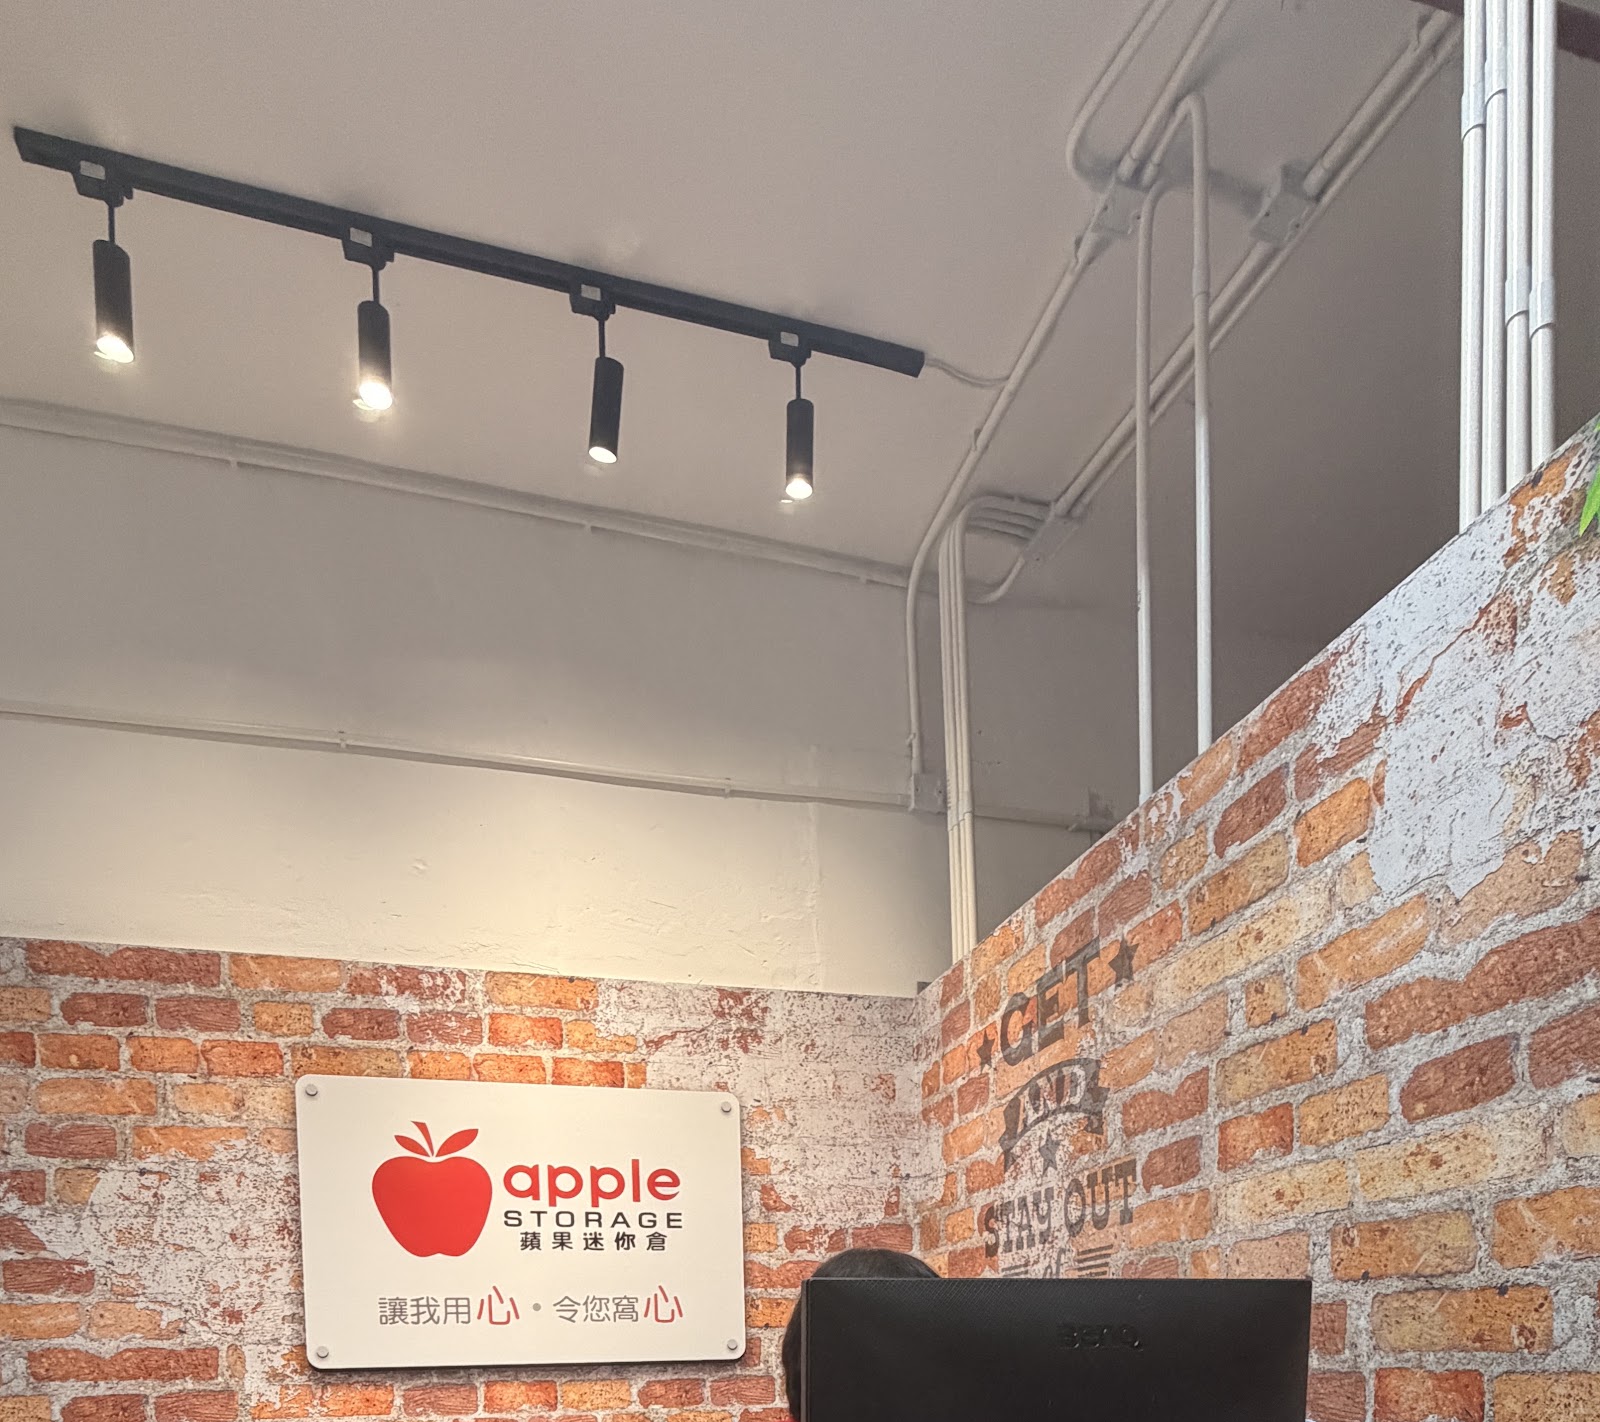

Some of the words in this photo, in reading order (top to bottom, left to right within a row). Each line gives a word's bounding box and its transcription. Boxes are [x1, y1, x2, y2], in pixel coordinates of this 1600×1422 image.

[1001, 938, 1100, 1066] GET
[503, 1158, 681, 1208] apple
[985, 1187, 1054, 1258] STAY
[1065, 1158, 1136, 1238] OUT
[503, 1210, 684, 1230] STORAGE
[519, 1230, 669, 1252] 蘋果迷你倉
